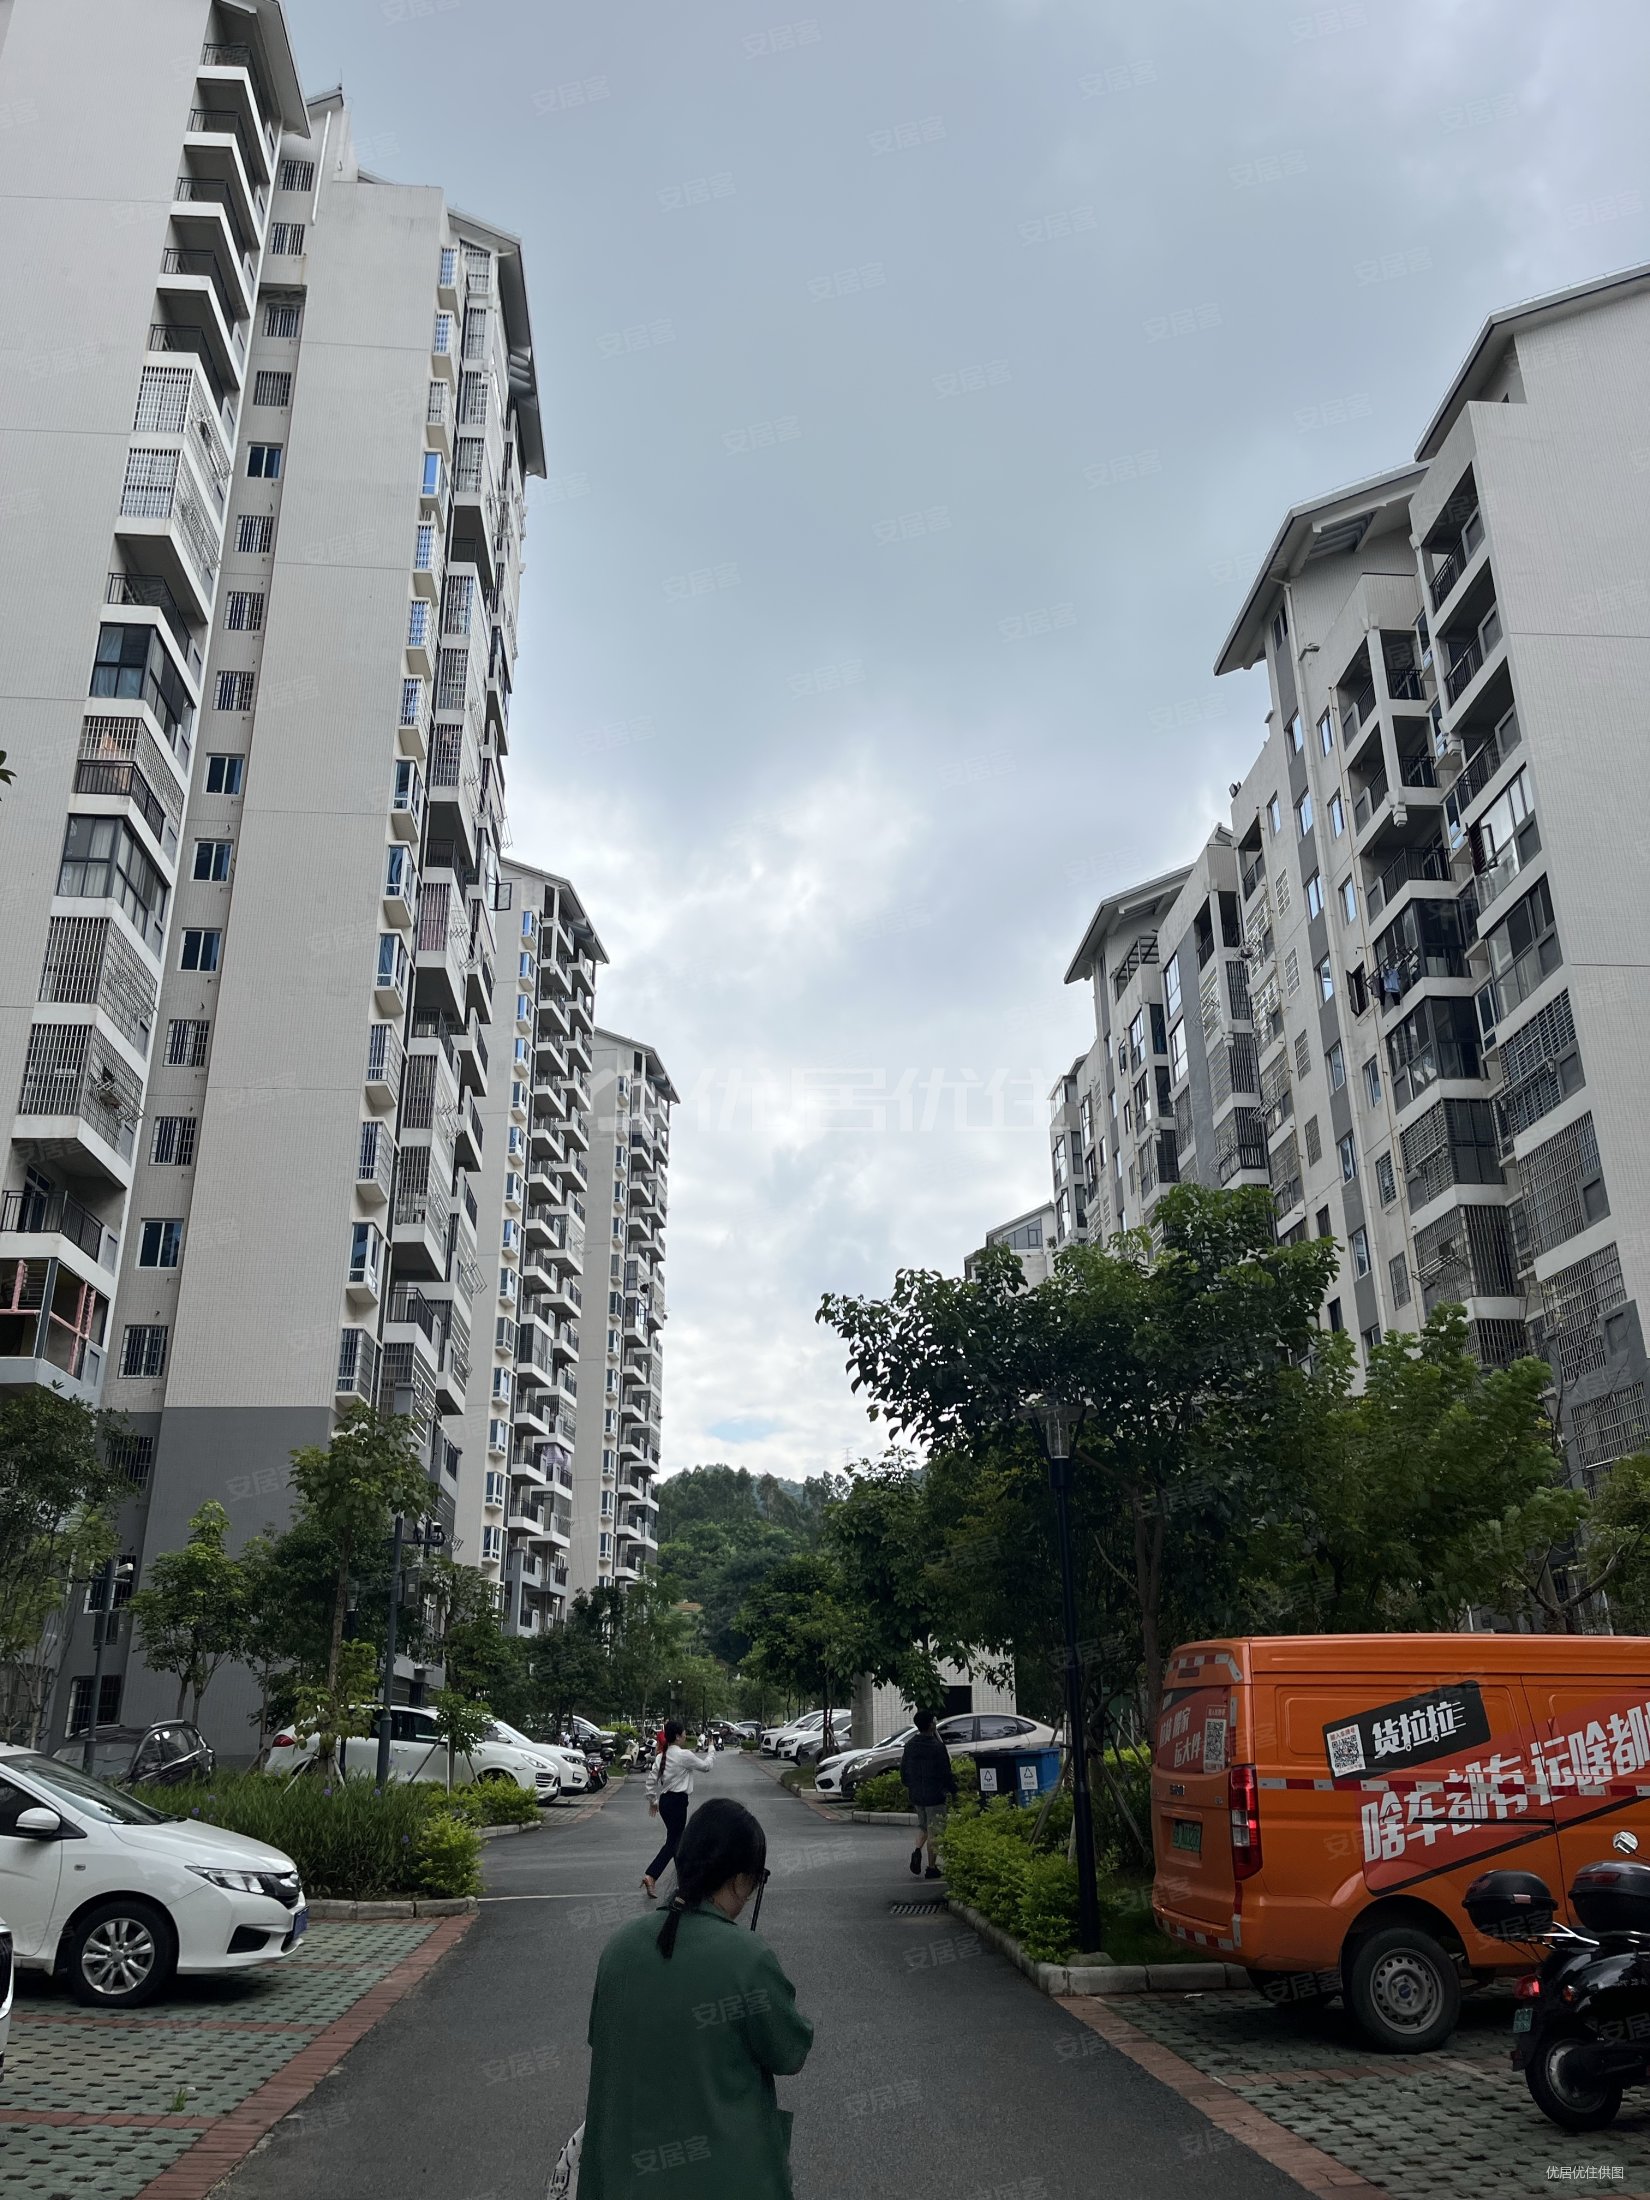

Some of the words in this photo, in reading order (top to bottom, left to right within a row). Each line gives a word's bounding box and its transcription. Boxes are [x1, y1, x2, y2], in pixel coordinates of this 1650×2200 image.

[1361, 1754, 1528, 1863] 啥车都有
[1531, 1702, 1650, 1807] 运啥都
[1371, 1701, 1460, 1760] 货拉拉
